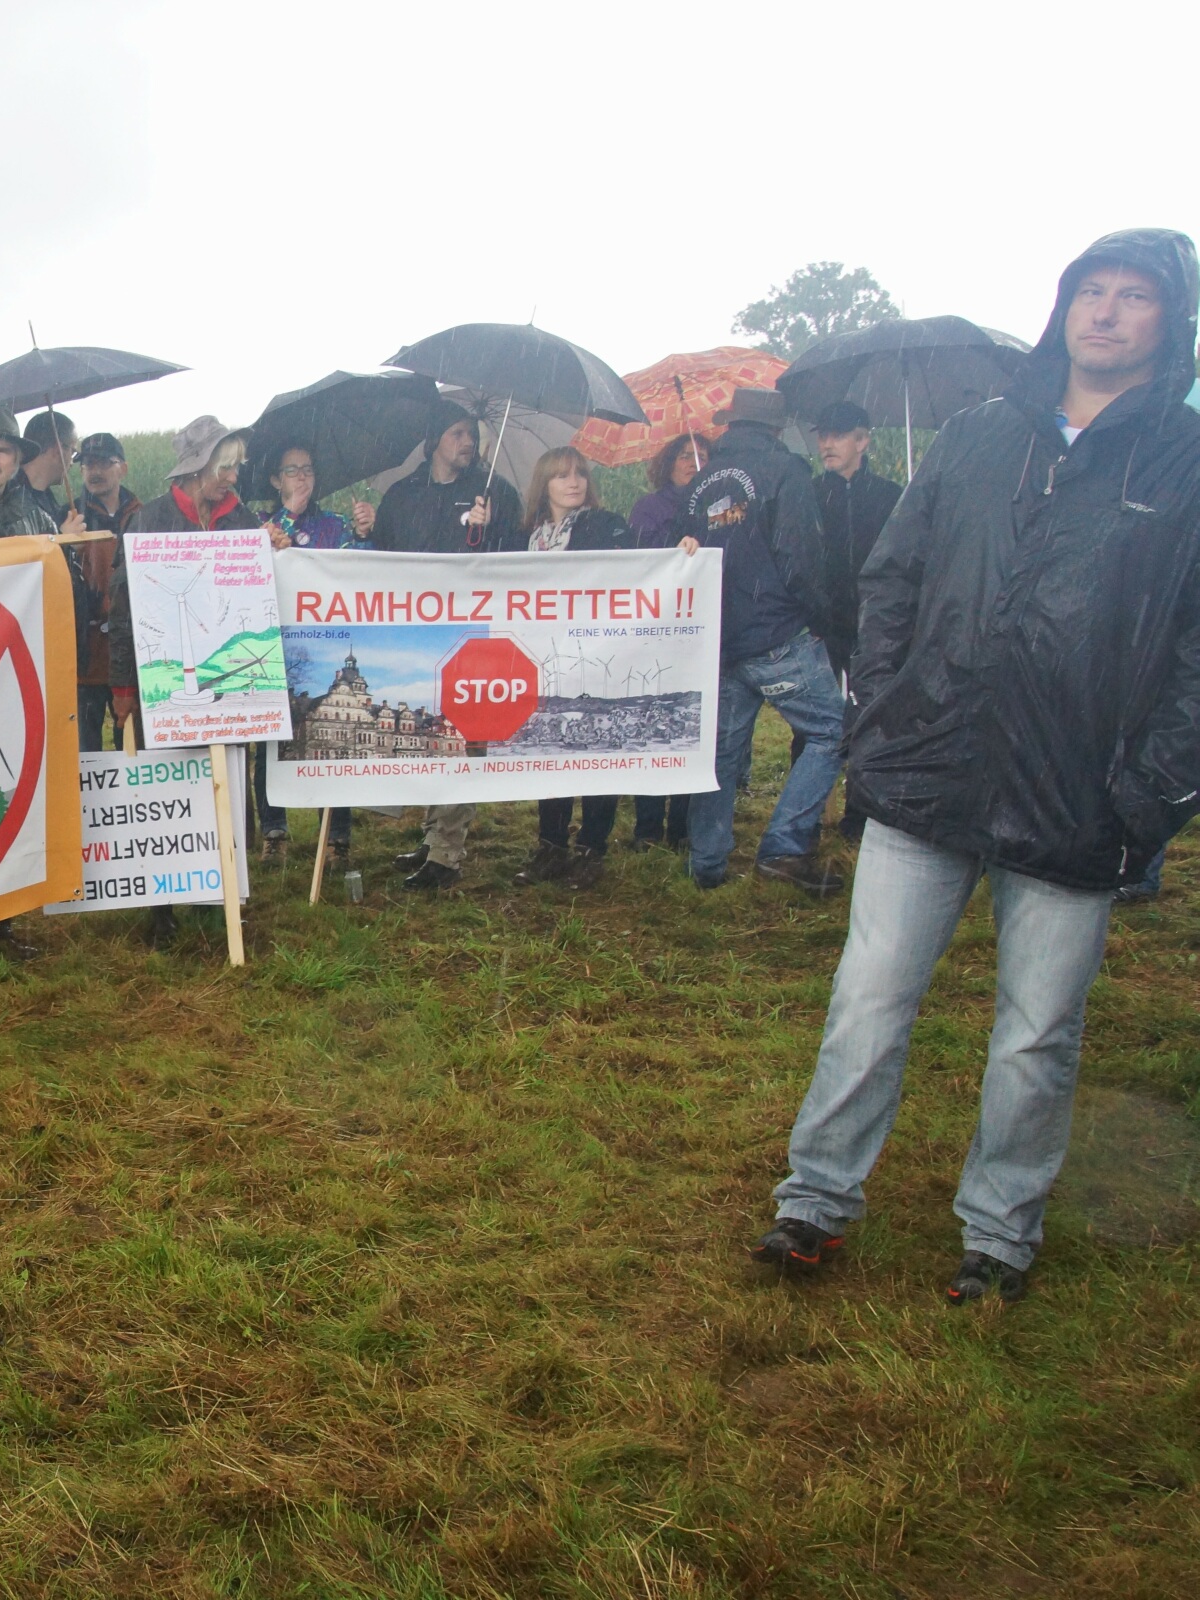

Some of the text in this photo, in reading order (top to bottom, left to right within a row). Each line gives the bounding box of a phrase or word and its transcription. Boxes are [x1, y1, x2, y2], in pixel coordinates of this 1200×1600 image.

[689, 468, 756, 515] KUTSCHERFREUNDE
[165, 534, 231, 551] Industriegebiete
[132, 551, 159, 563] Natur
[160, 550, 179, 562] und
[214, 550, 227, 561] ist
[296, 587, 694, 623] RAMHOLZ RETTEN !!
[568, 625, 705, 638] KEINE WKA "BREITE FIRST"
[453, 678, 527, 704] STOP
[171, 730, 199, 742] Bürger
[297, 763, 450, 777] KULTURLANDSCHAFT,
[453, 763, 470, 774] JA
[483, 758, 647, 773] INDUSTRIELANDSCHAFT,
[651, 756, 686, 769] NEIN!
[80, 768, 119, 791] ZAH
[83, 798, 191, 828] KASSIERT,
[82, 831, 219, 863] INDKRAFTMA
[85, 869, 221, 900] OLITIK BEDIE
